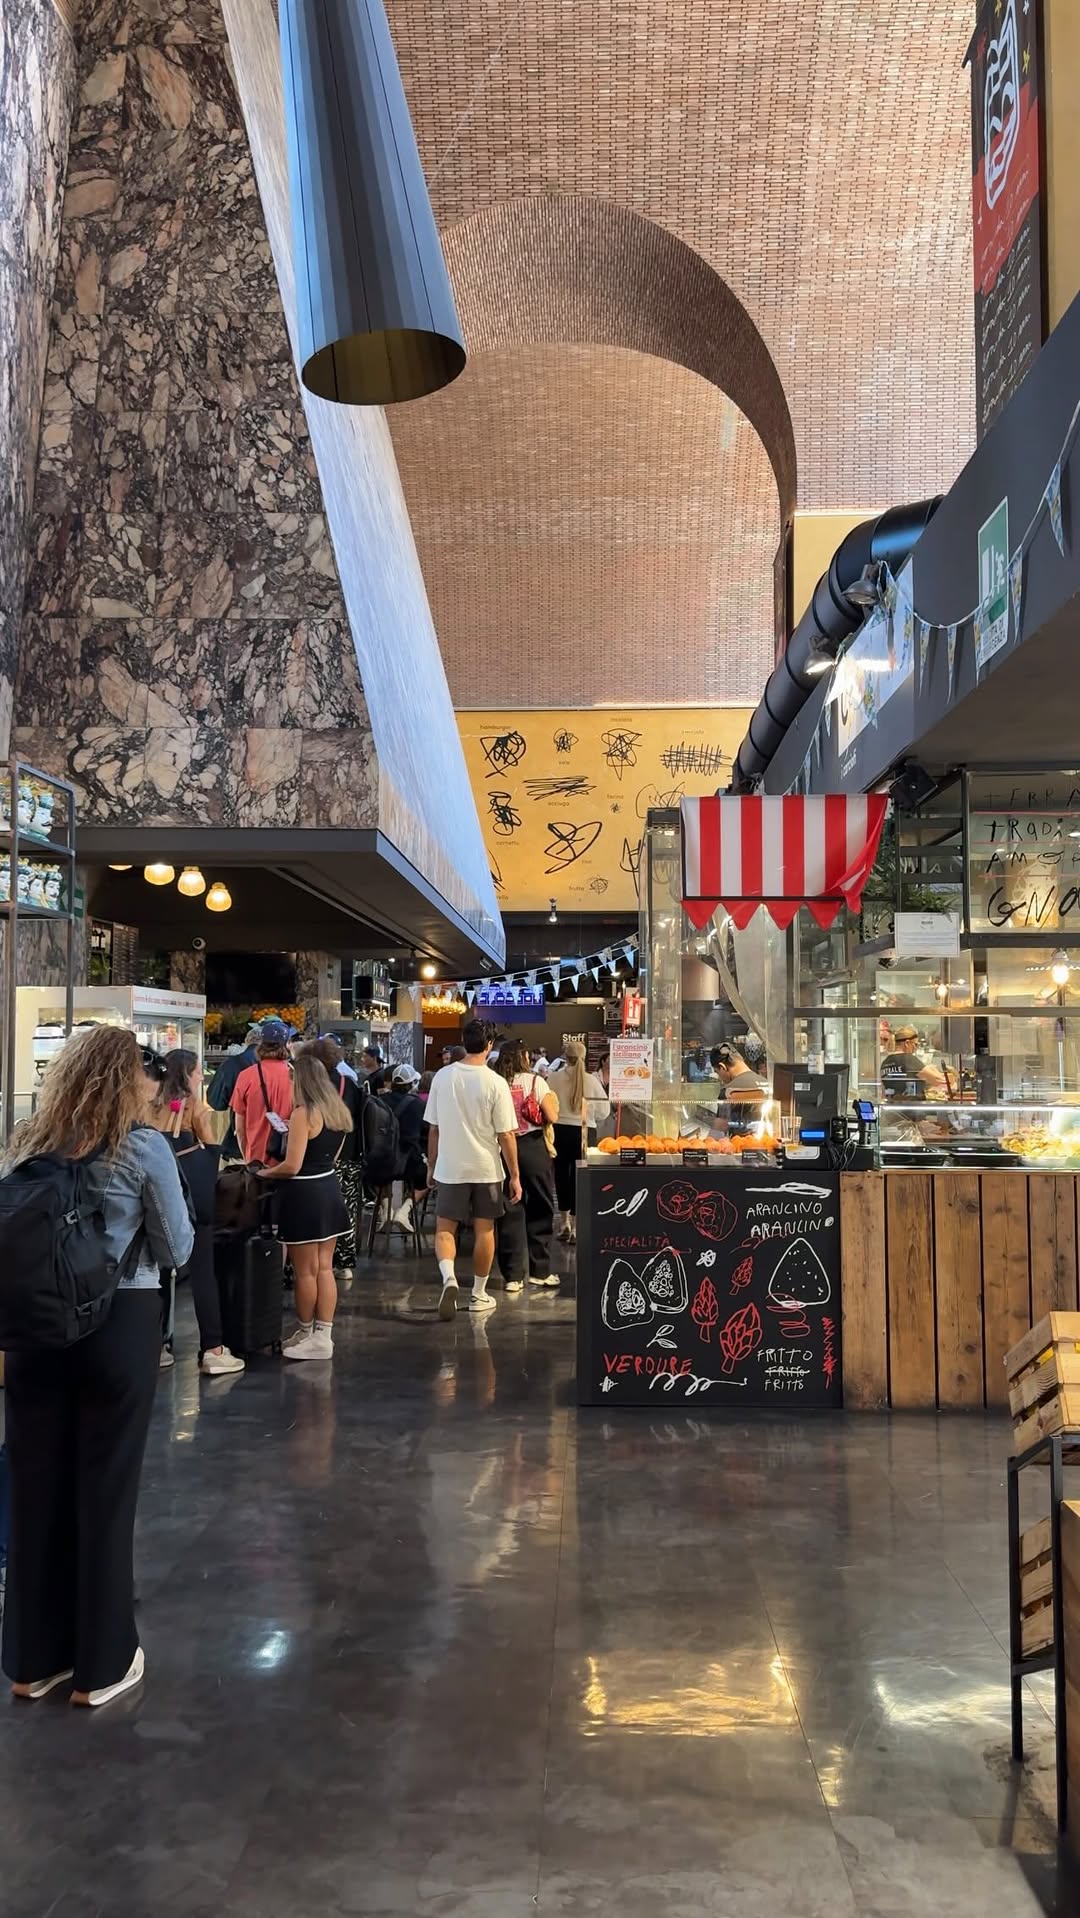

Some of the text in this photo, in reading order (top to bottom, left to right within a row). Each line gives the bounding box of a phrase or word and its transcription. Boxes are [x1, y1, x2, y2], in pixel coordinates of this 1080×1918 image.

[562, 1033, 586, 1042] Staff
[746, 1201, 823, 1219] ARANCINO
[757, 1347, 813, 1363] FRITTO
[603, 1352, 693, 1376] VERDURE
[764, 1379, 805, 1391] FRITTO
